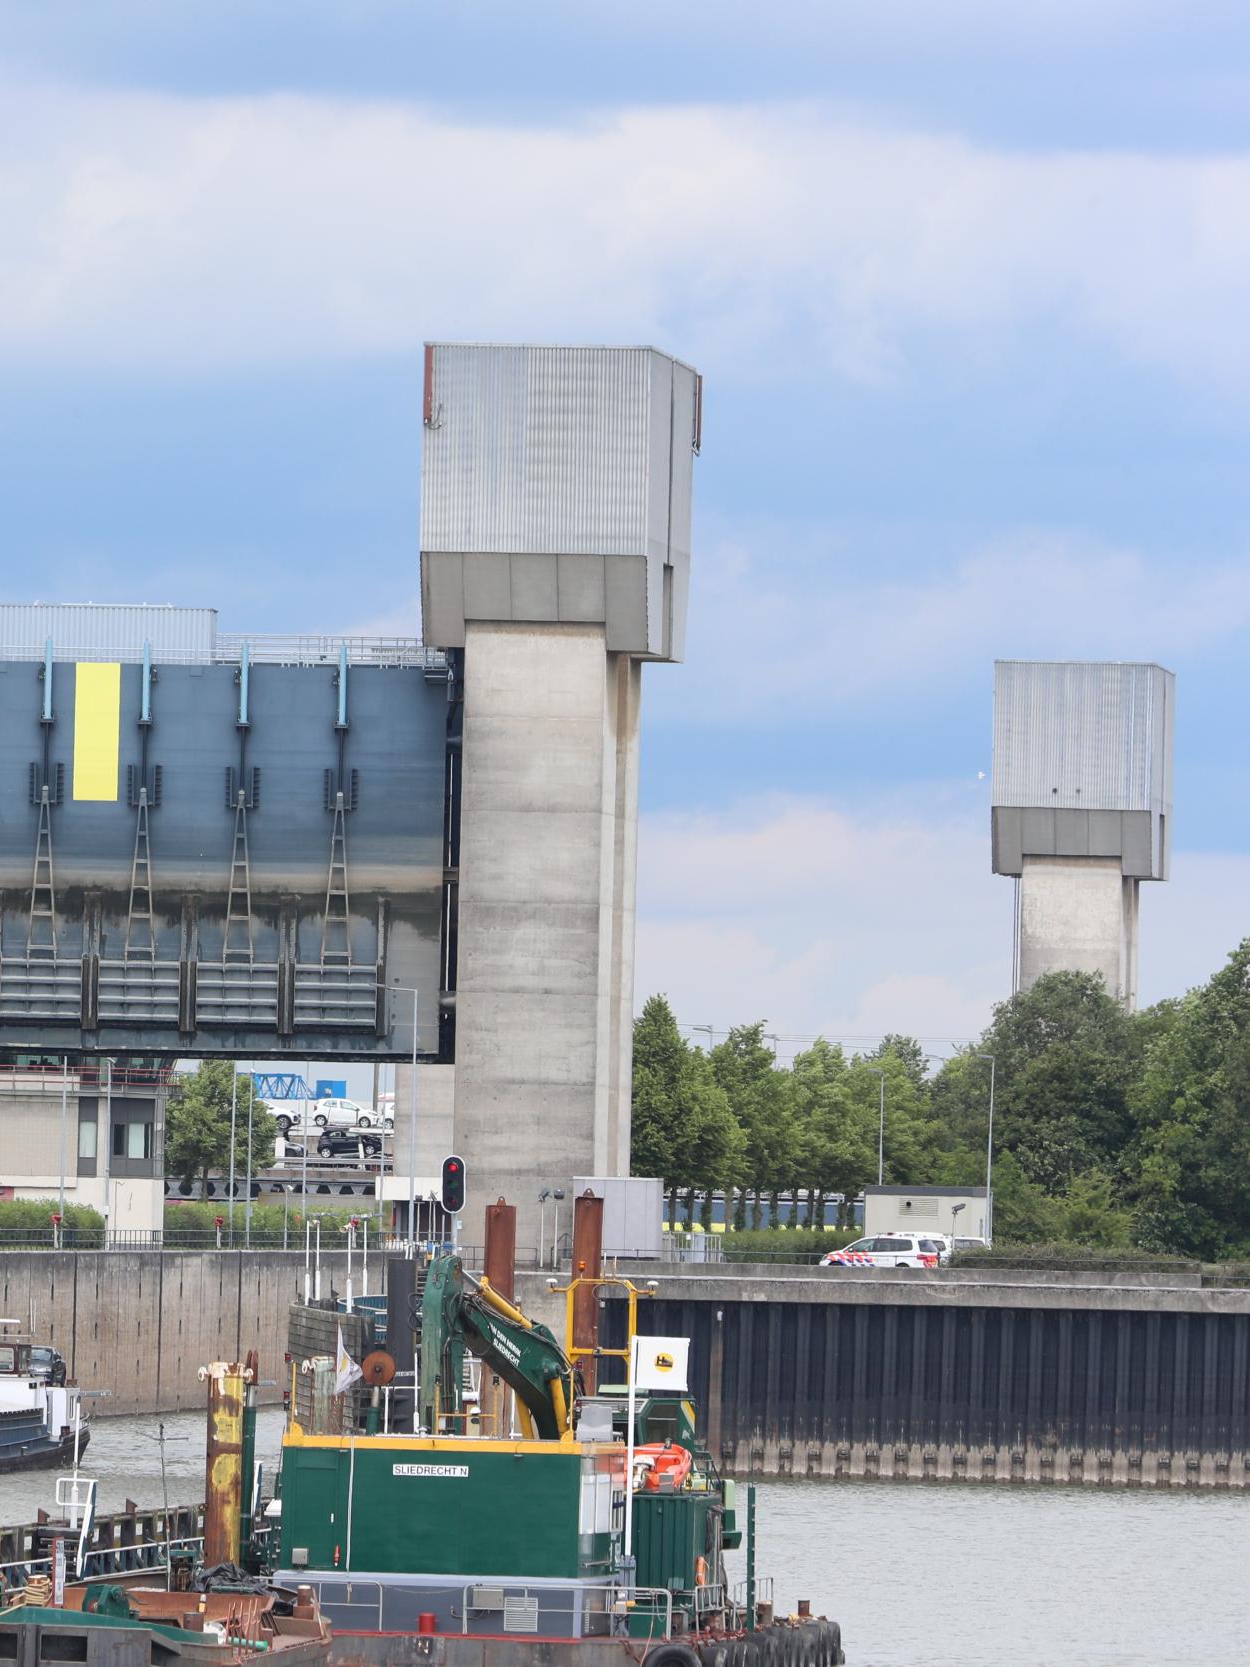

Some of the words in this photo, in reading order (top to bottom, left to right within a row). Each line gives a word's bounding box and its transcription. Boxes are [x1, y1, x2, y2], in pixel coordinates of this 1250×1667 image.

[496, 1329, 508, 1345] DEN
[394, 1465, 457, 1475] SLIEDRECHT
[460, 1467, 468, 1476] N
